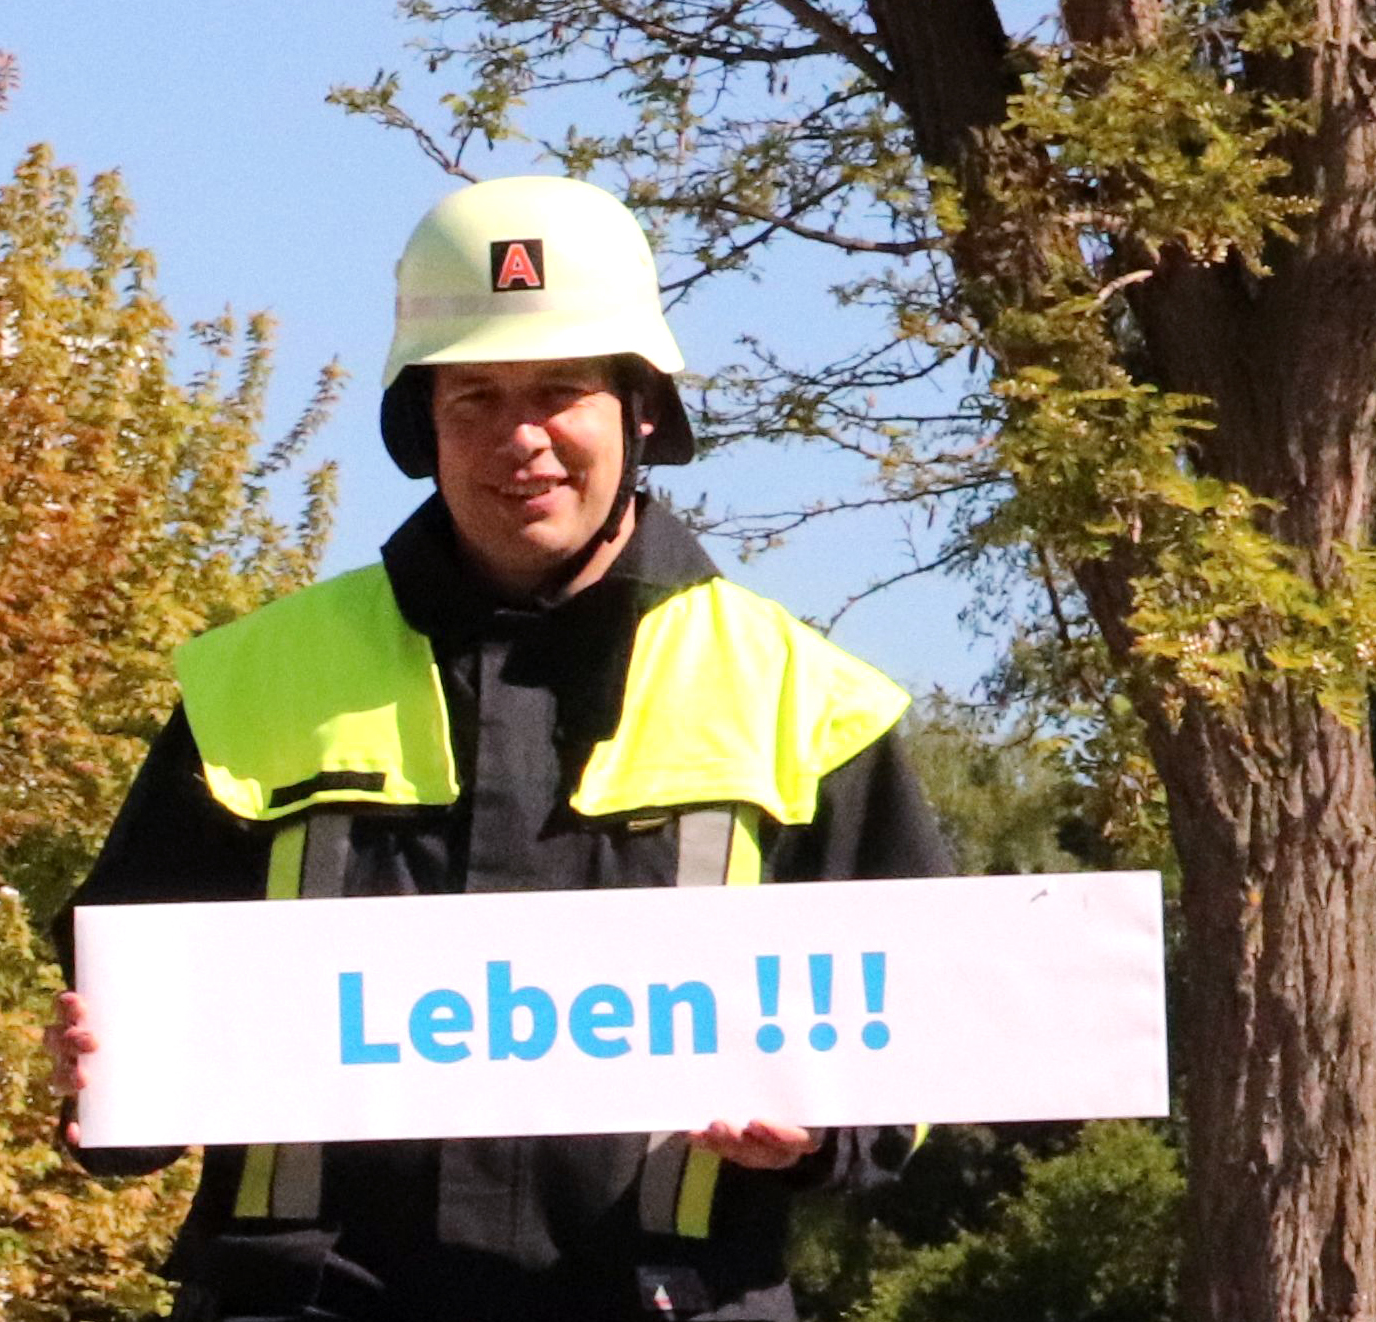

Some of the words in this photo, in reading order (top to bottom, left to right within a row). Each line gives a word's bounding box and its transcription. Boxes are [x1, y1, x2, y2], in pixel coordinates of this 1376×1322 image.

[497, 243, 540, 287] A
[339, 961, 717, 1065] Leben
[756, 953, 889, 1053] !!!
